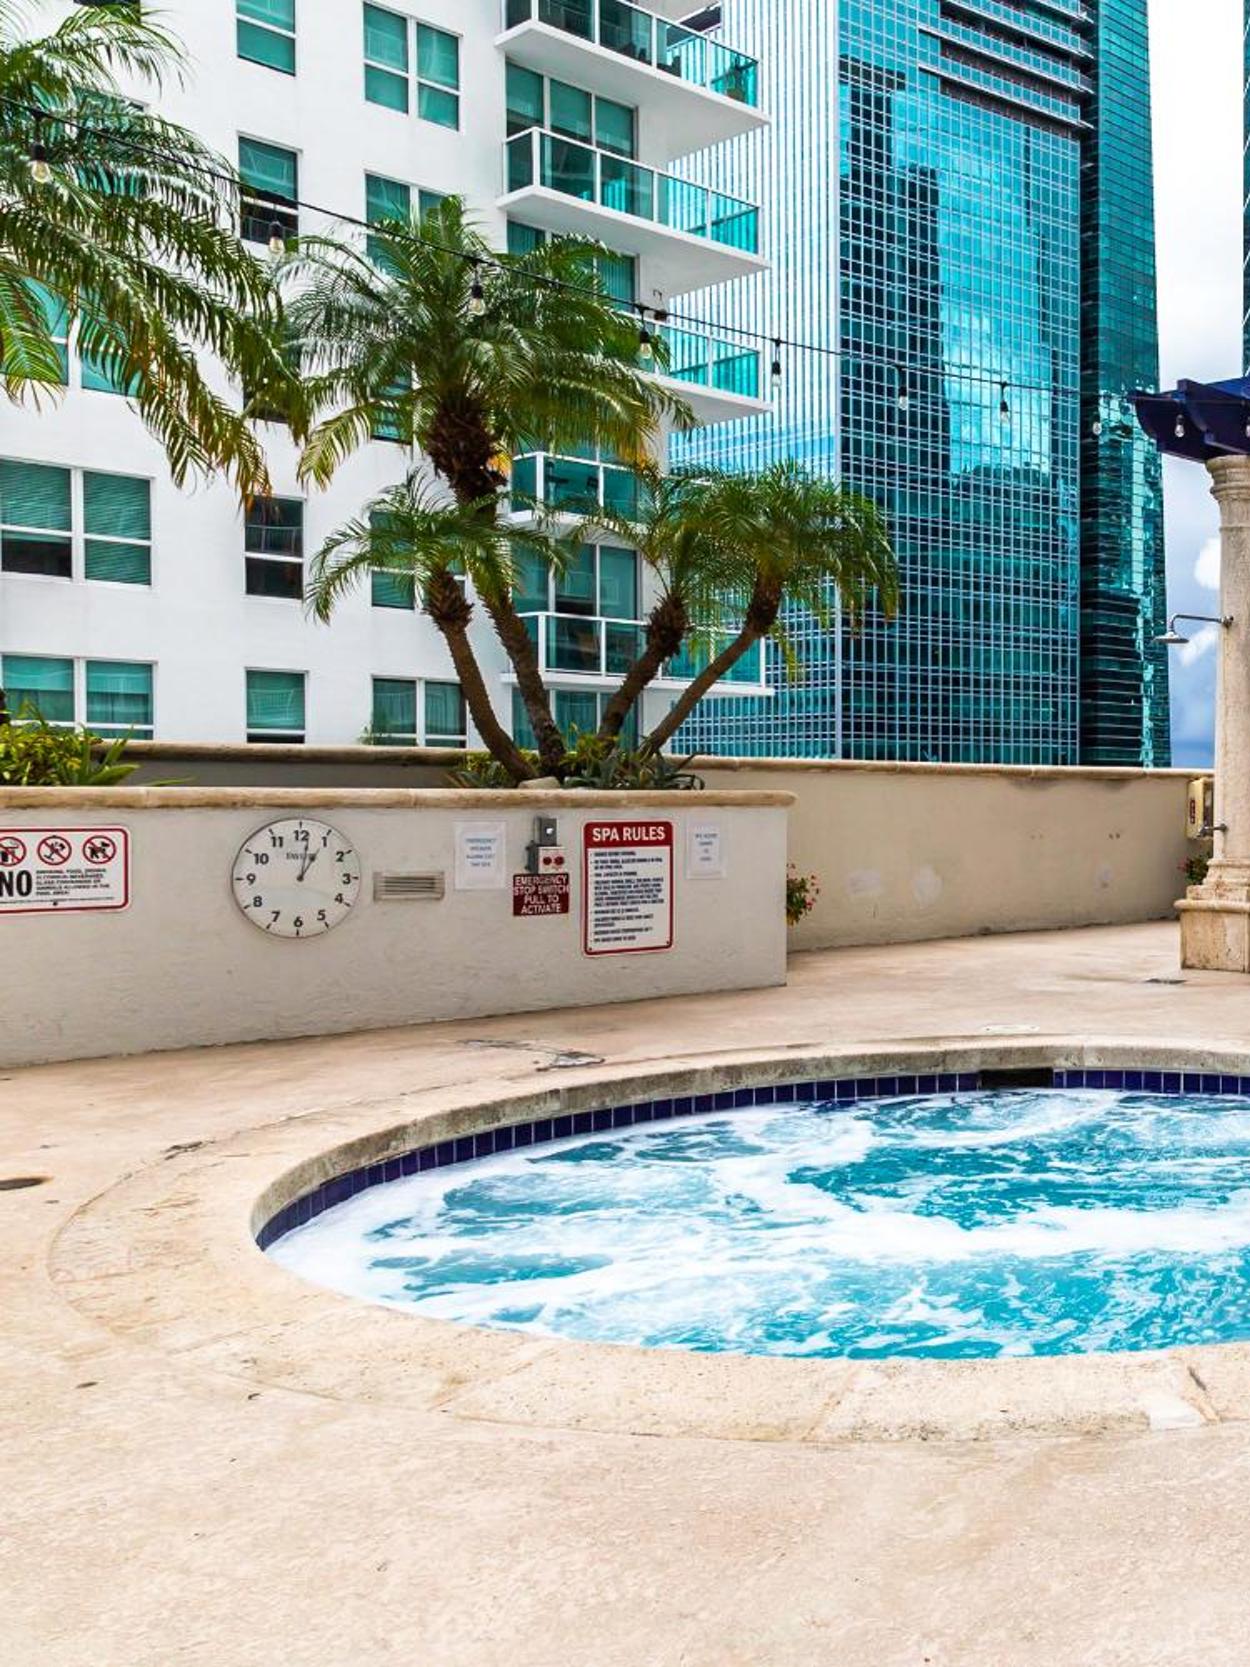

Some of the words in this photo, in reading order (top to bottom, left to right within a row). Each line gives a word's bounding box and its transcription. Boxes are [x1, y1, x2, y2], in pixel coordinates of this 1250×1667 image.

[293, 830, 310, 841] 12
[592, 827, 620, 841] SPA
[622, 826, 666, 840] RULES
[271, 836, 284, 848] 11
[321, 836, 328, 848] 1
[254, 853, 269, 865] 10
[335, 851, 345, 862] 2
[0, 870, 32, 897] NO
[246, 873, 256, 885] 9
[342, 873, 351, 885] 3
[514, 875, 568, 886] EMERGENCY
[513, 886, 536, 896] STOP
[538, 884, 569, 895] SWITCH
[253, 896, 263, 908] 8
[334, 893, 344, 904] 4
[524, 895, 545, 904] PULL
[547, 894, 560, 903] TO
[521, 903, 561, 914] ACTIVATE
[271, 911, 281, 922] 7
[316, 909, 326, 921] 5
[293, 916, 303, 928] 6
